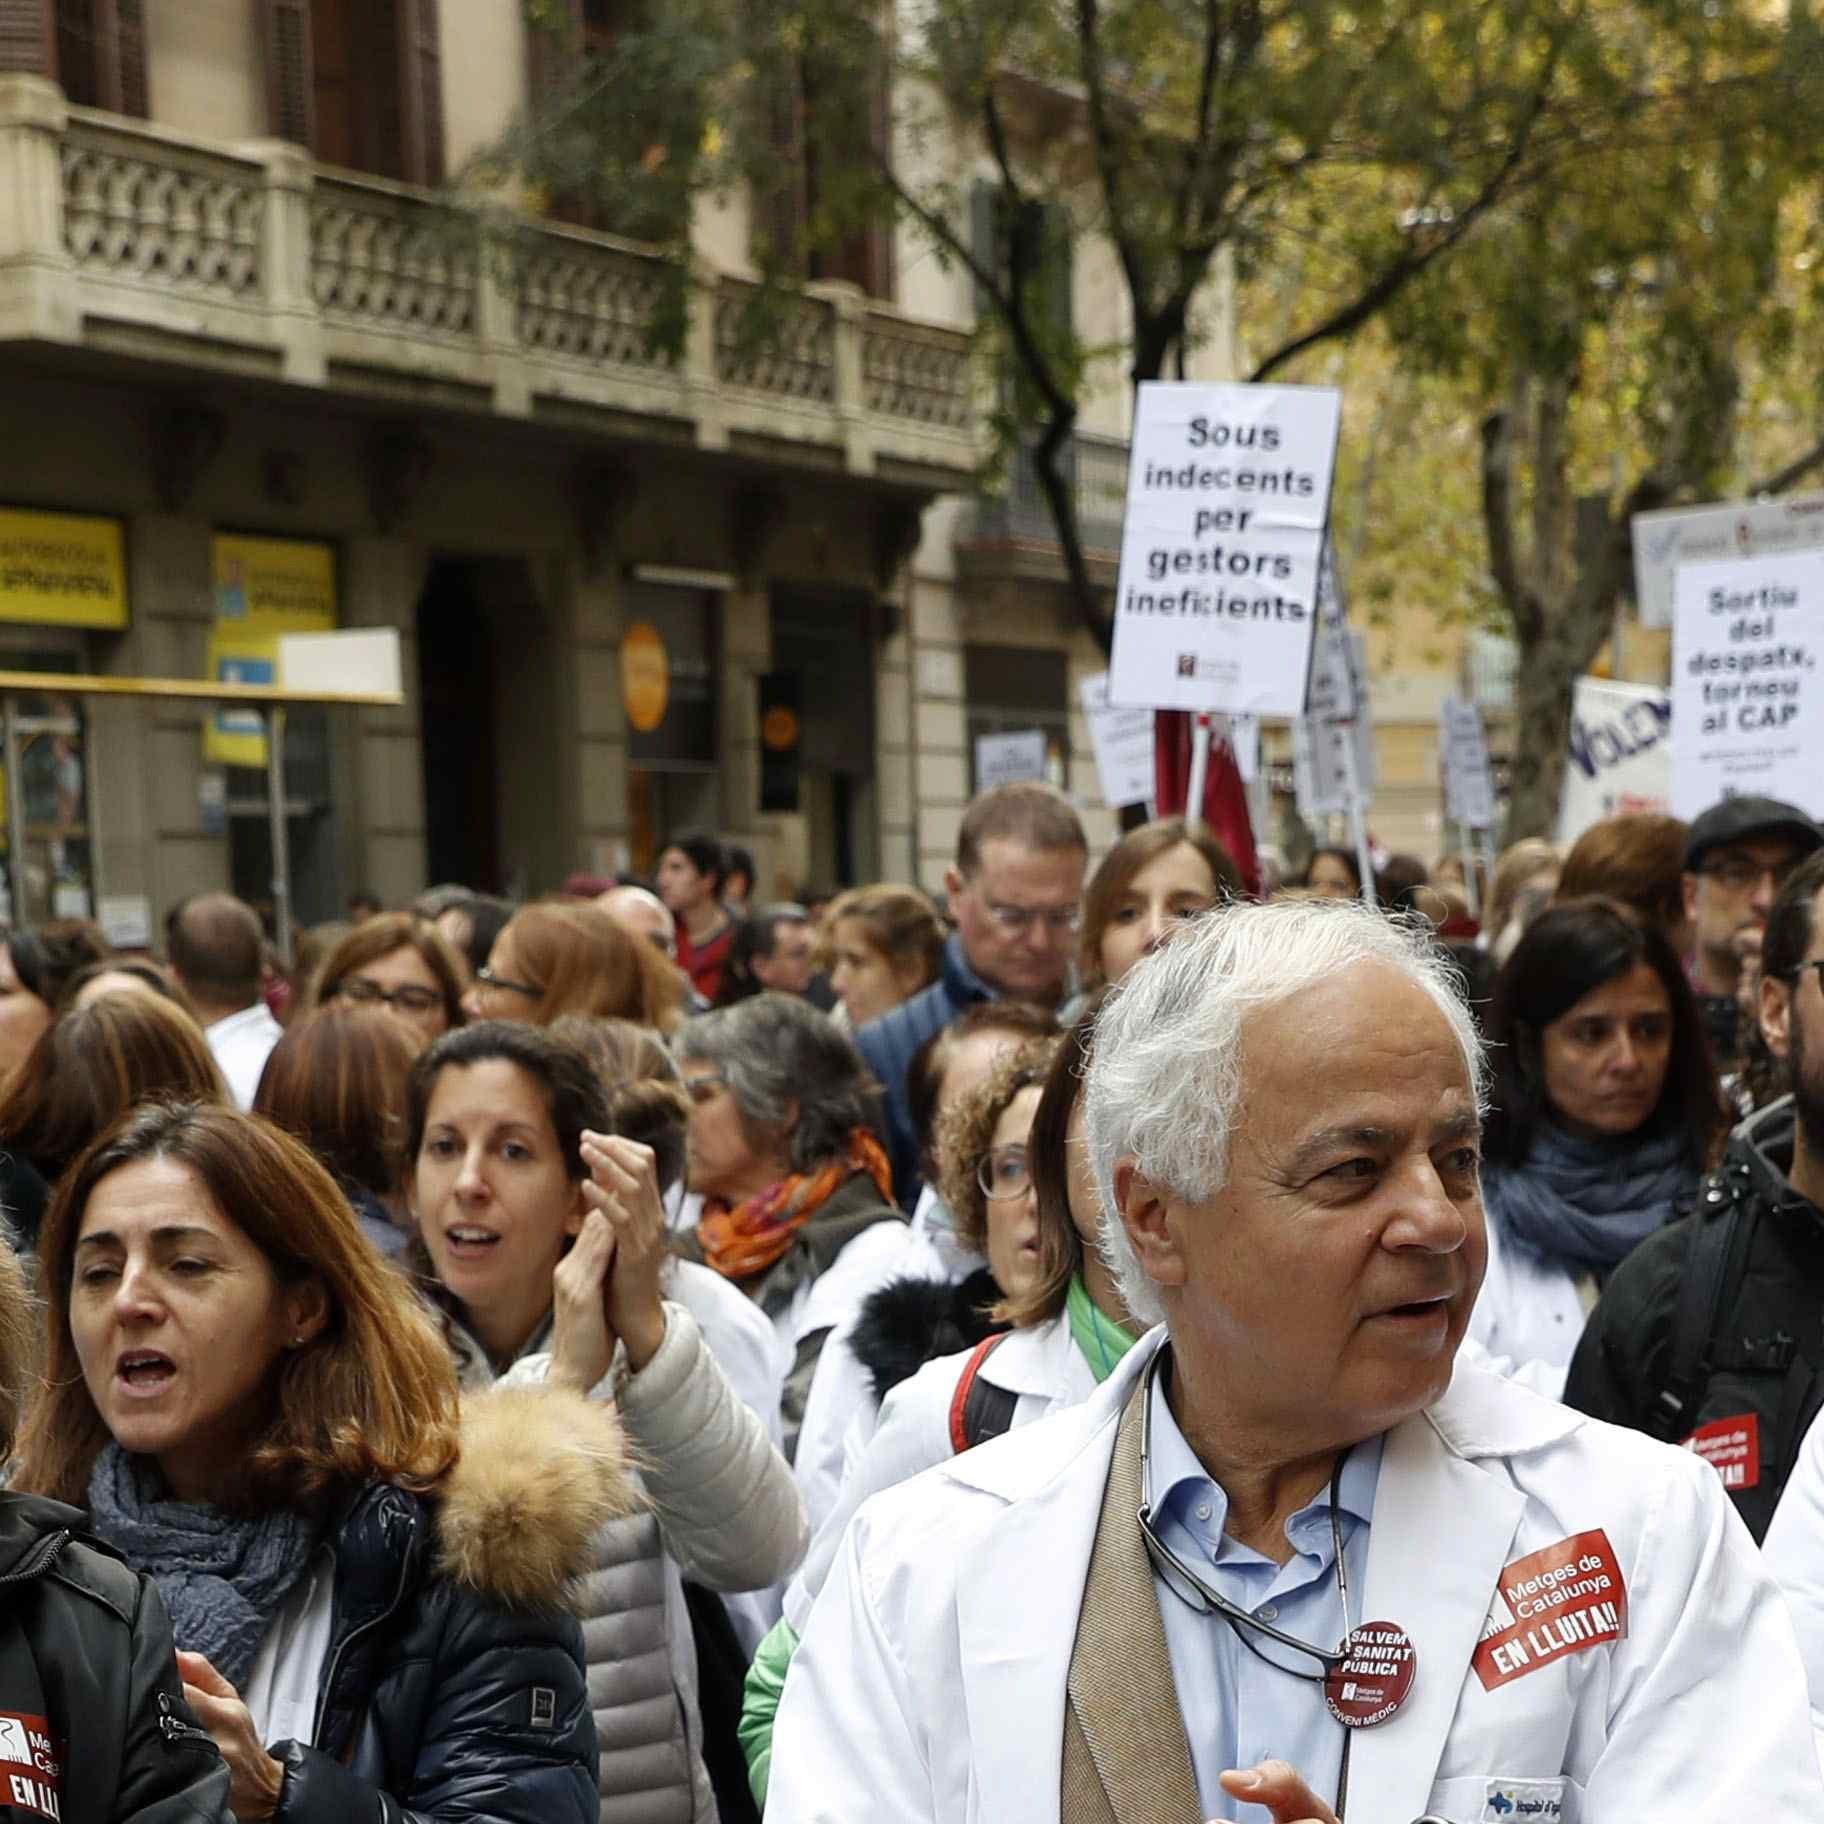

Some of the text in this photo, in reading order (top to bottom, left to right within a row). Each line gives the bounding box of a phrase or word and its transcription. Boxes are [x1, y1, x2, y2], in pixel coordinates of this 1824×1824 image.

[1189, 417, 1280, 448] Sous
[1144, 463, 1314, 496] indecents
[1194, 507, 1253, 539] per
[1148, 547, 1291, 579] gestors
[1126, 588, 1306, 622] ineficients
[1708, 586, 1798, 614] Sortiu
[1729, 616, 1774, 642] del
[1702, 704, 1799, 734] al CAP
[1507, 1555, 1602, 1602] Metges de
[1517, 1575, 1611, 1618] Catalunya
[1351, 1631, 1408, 1645] SALVEM
[1490, 1601, 1619, 1674] EN LLUITA!!
[1342, 1659, 1398, 1676] PÚBLICA
[1353, 1646, 1411, 1661] SANITAT
[1327, 1697, 1362, 1726] CONVENI
[9, 1775, 37, 1808] EN
